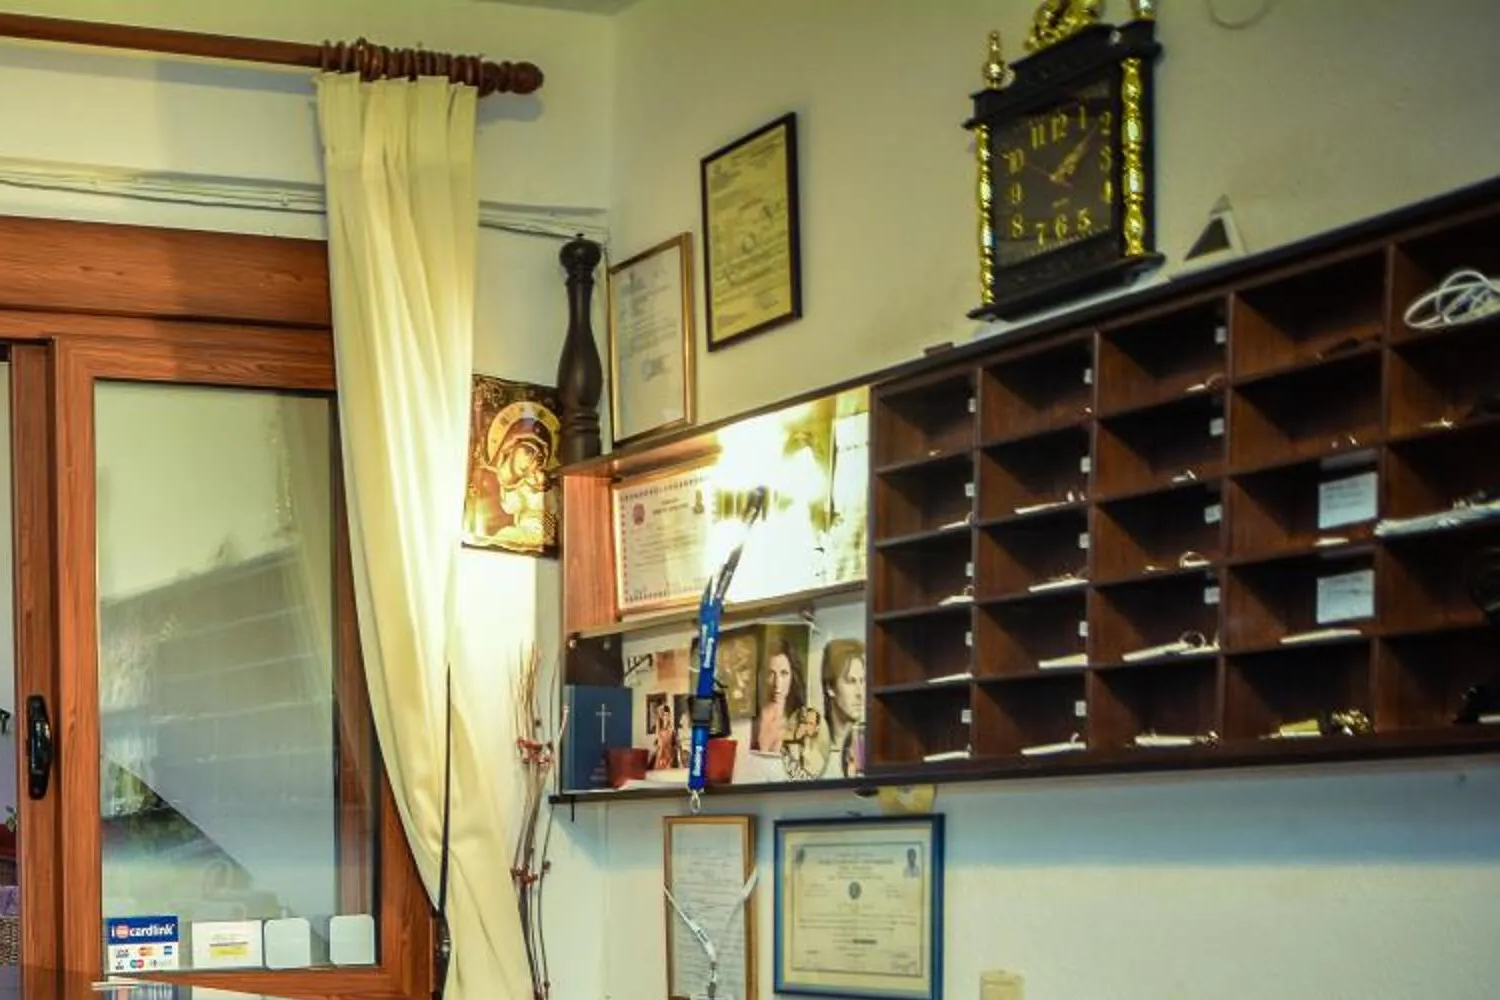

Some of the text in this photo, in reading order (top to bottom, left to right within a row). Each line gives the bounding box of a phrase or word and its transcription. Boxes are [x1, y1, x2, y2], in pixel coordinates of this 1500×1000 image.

[1031, 123, 1046, 149] 11
[1051, 113, 1068, 142] 12
[1011, 214, 1024, 239] 8
[1055, 213, 1068, 240] 6
[1077, 207, 1092, 231] 5
[1035, 223, 1045, 246] 7
[129, 923, 173, 937] cardlink
